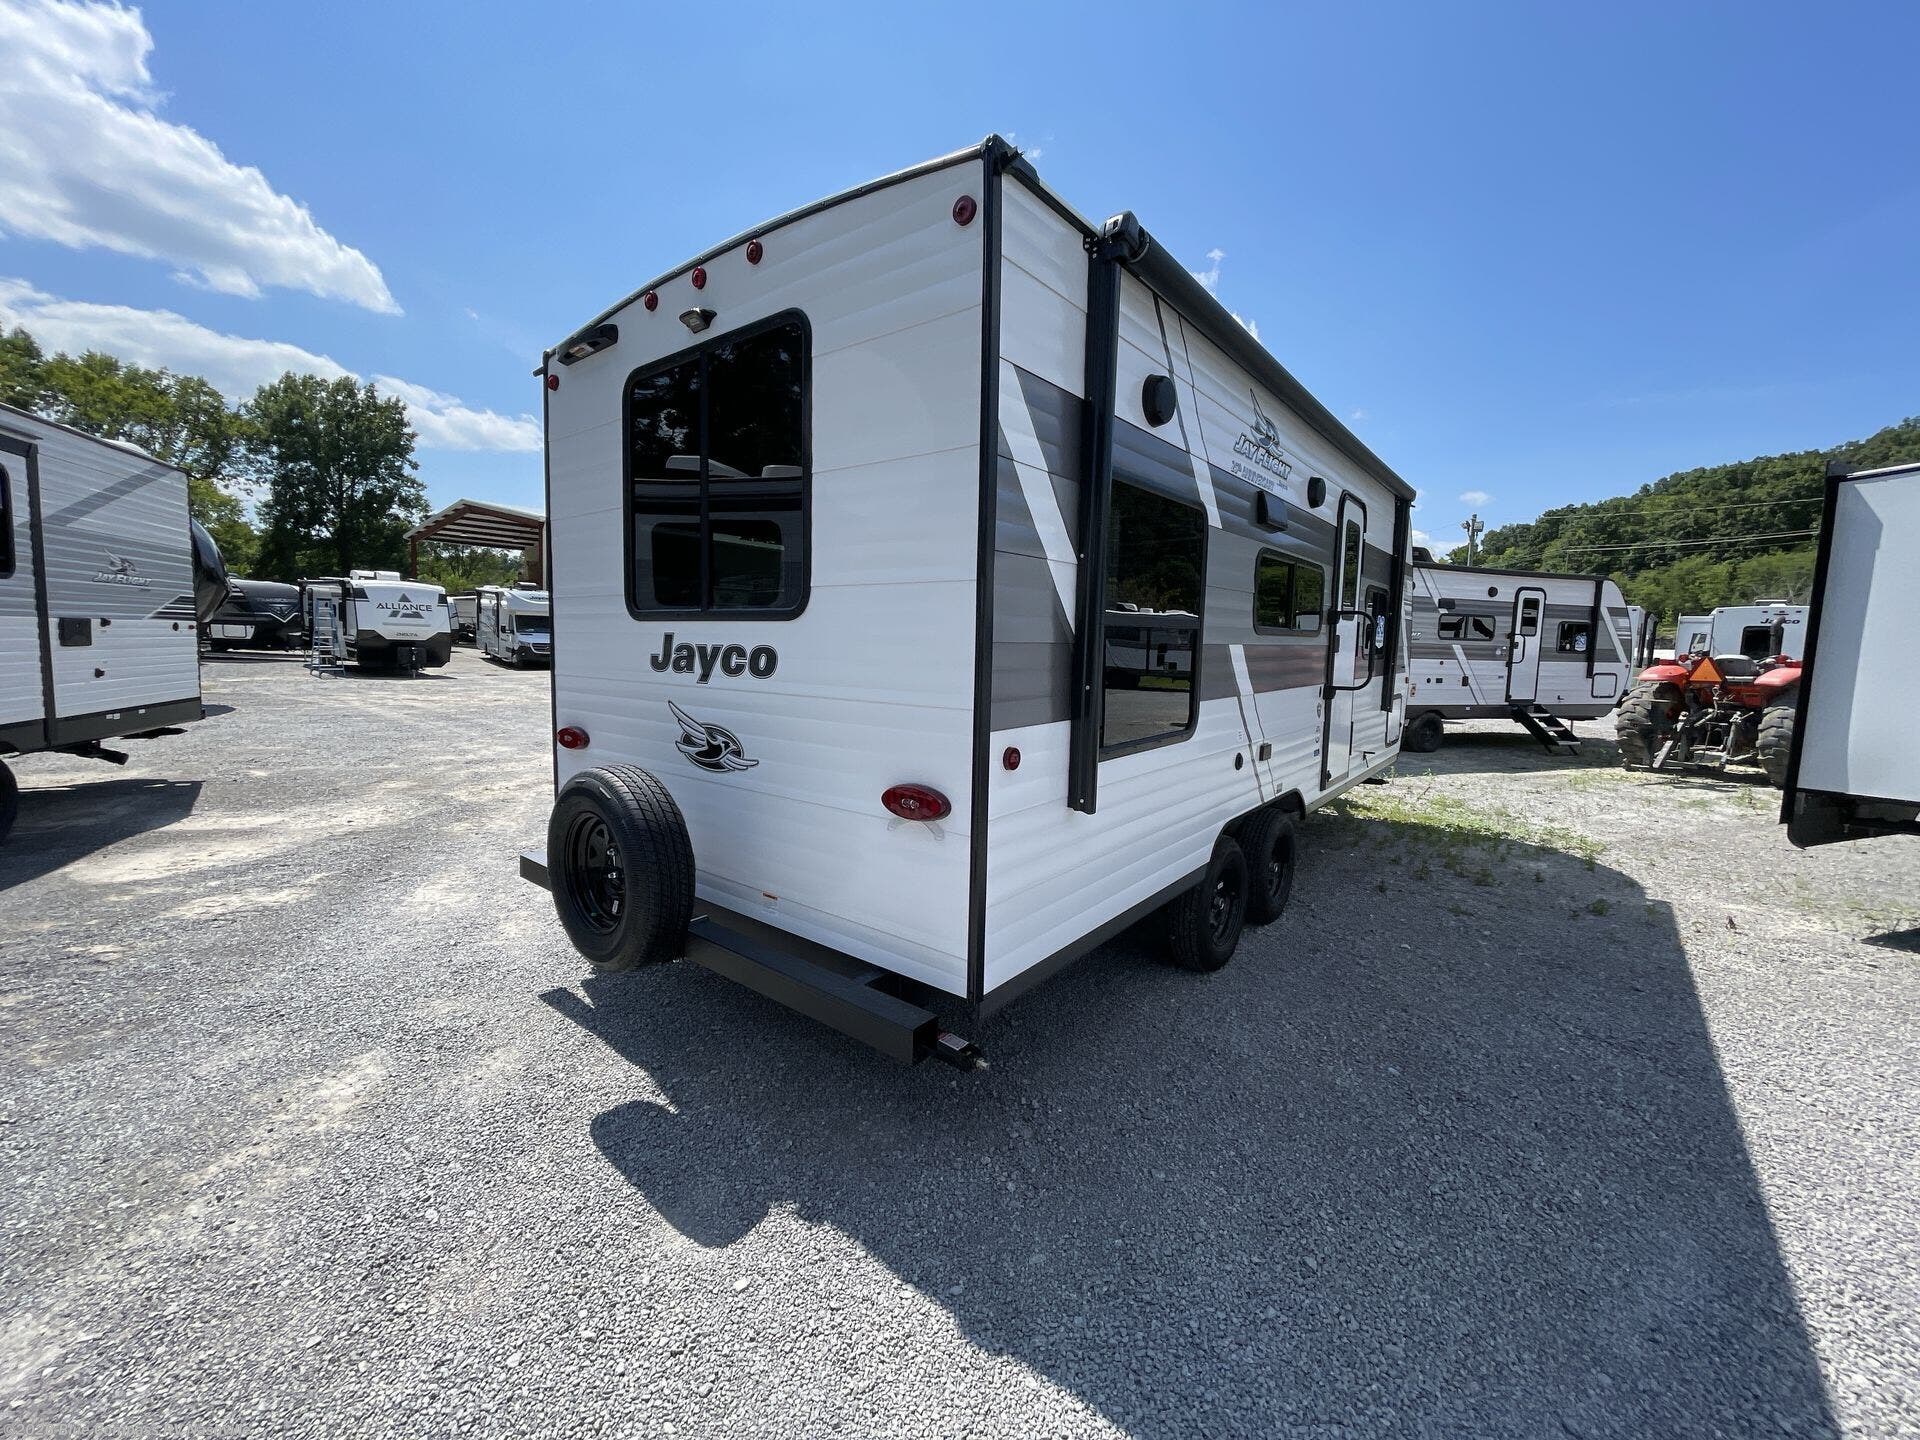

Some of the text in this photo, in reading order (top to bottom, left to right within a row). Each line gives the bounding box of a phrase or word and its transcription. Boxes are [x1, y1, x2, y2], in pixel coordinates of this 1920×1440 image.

[1233, 432, 1259, 460] JAY
[1254, 445, 1292, 480] FLIGHT
[92, 571, 152, 587] JAY FLIGHT
[376, 602, 433, 612] ALLIANCE
[650, 631, 779, 684] Jayco
